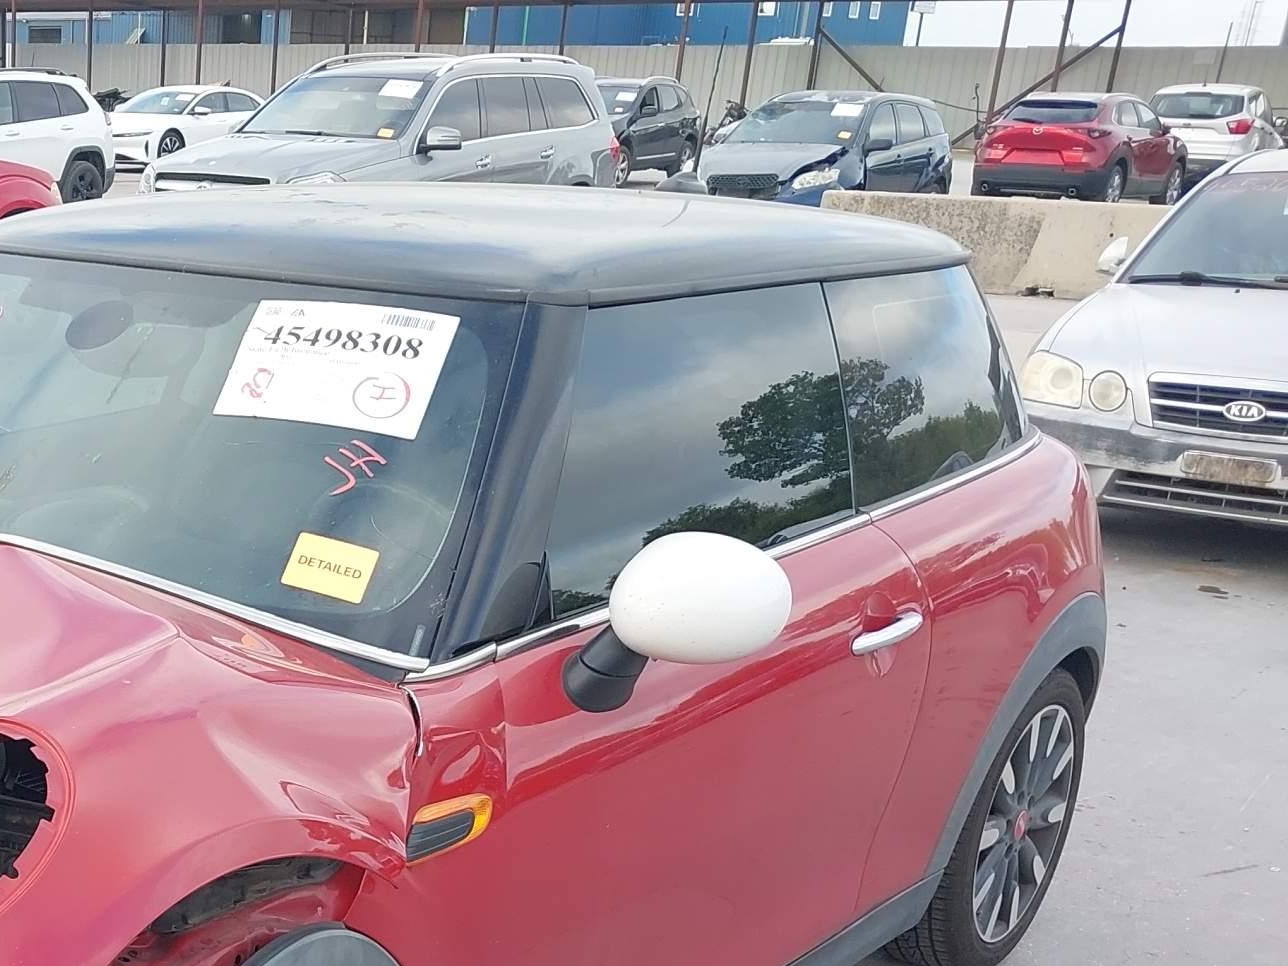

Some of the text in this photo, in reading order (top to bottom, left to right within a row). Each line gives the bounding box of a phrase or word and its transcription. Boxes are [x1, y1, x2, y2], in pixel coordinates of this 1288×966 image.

[263, 325, 424, 360] 45498308
[1229, 404, 1259, 418] KIA
[297, 554, 363, 580] DETAILED
